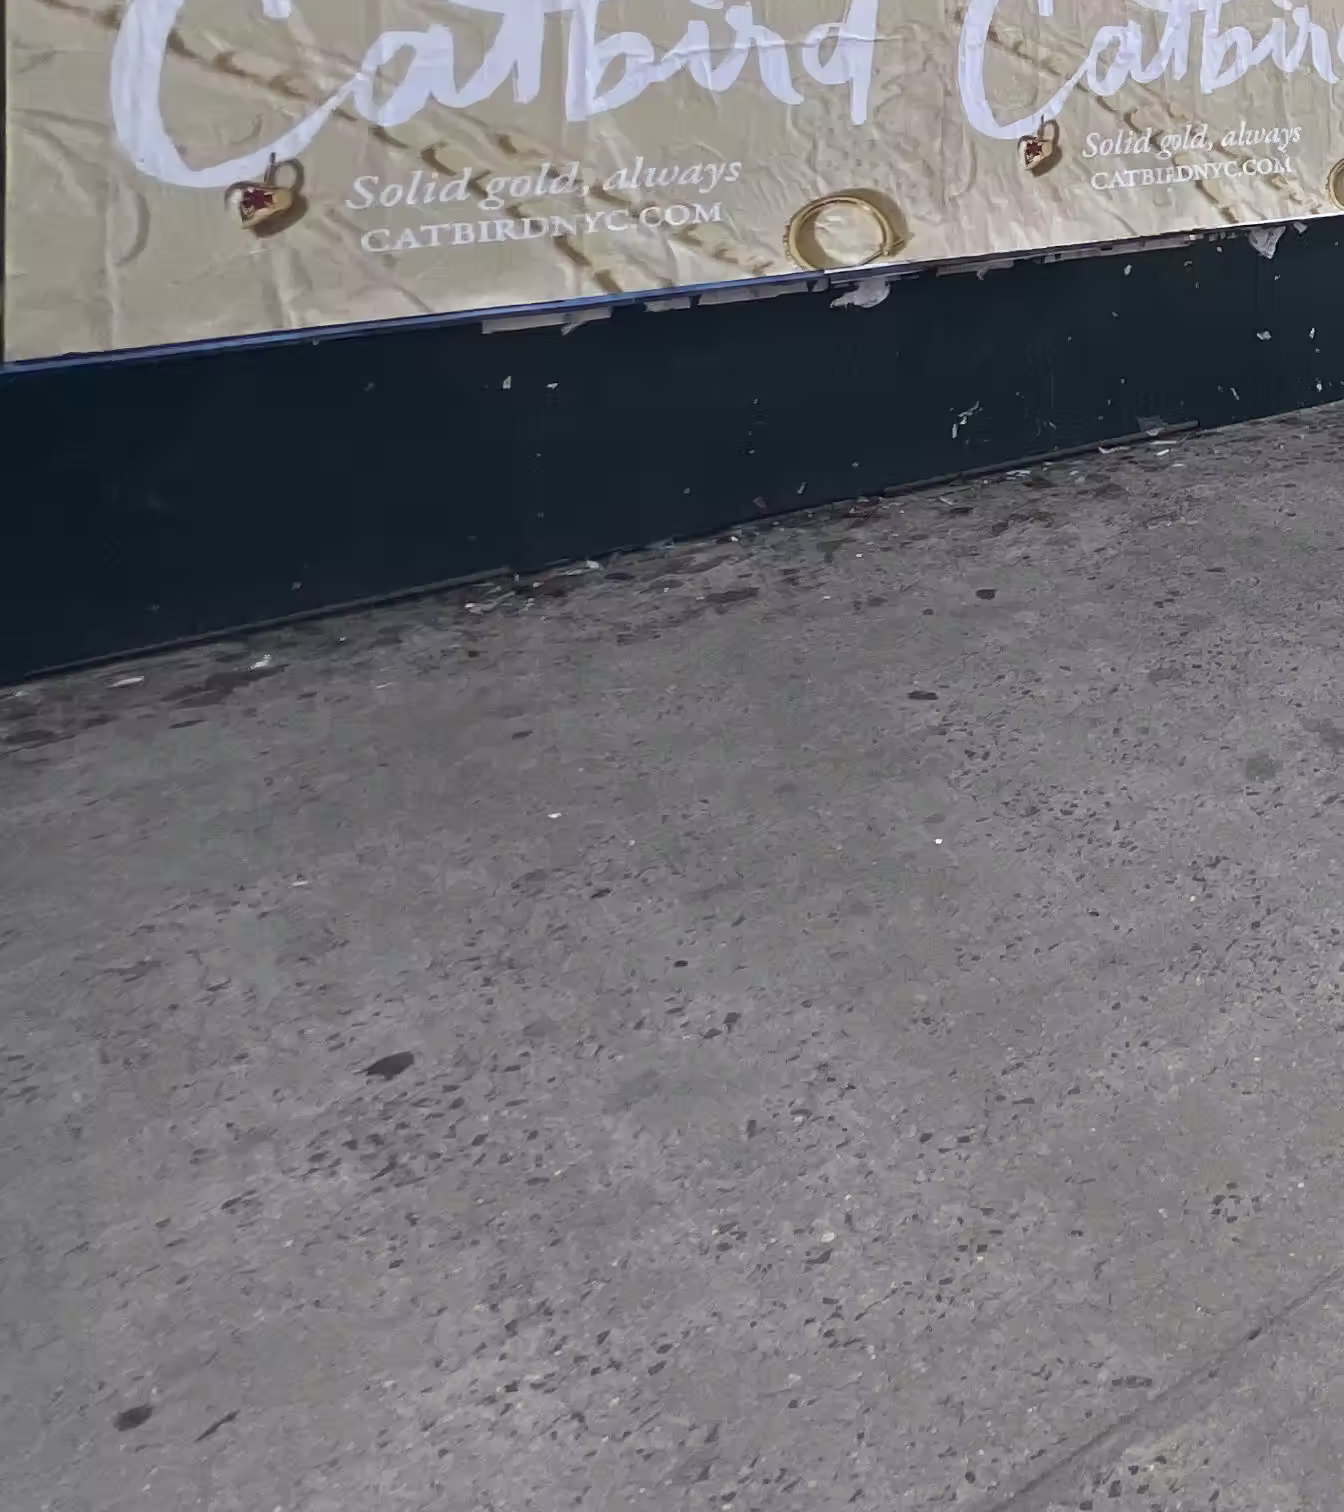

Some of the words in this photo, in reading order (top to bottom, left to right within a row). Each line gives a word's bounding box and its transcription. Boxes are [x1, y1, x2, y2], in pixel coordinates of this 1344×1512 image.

[1082, 127, 1152, 158] Solid
[1156, 122, 1214, 161] gold,
[1220, 120, 1303, 154] always
[345, 166, 473, 210] Solid
[476, 160, 591, 211] gold,
[602, 155, 743, 194] always
[1090, 155, 1293, 191] CATBIRDNYC.COM
[360, 201, 723, 254] CATBIRDNYC.COM
